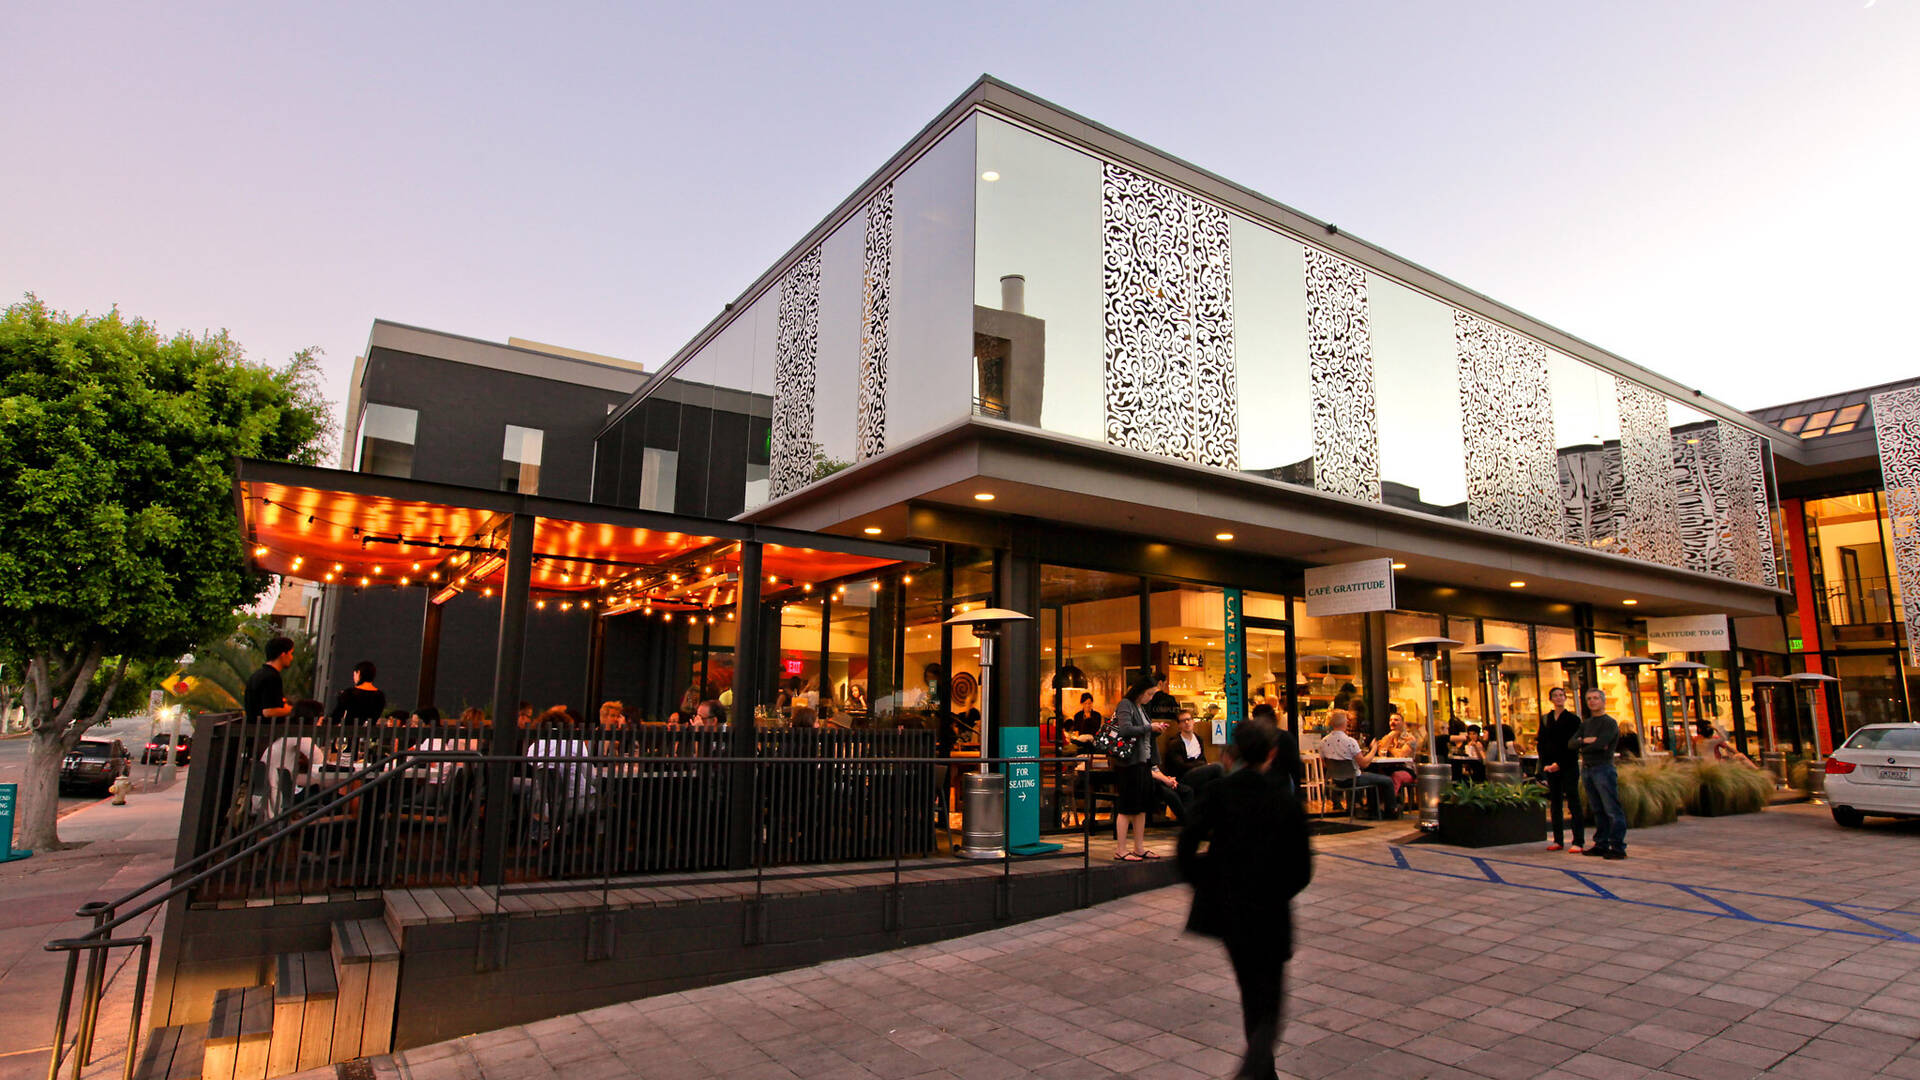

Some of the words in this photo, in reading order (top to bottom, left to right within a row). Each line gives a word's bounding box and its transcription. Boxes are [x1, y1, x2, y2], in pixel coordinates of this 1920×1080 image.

[1308, 585, 1331, 597] CAFÉ
[1333, 580, 1385, 594] GRATITUDE
[1649, 630, 1697, 638] GRATITUDE
[1214, 723, 1223, 736] A
[1016, 744, 1028, 753] SEE
[1016, 768, 1029, 776] FOR
[1009, 779, 1035, 789] SEATING
